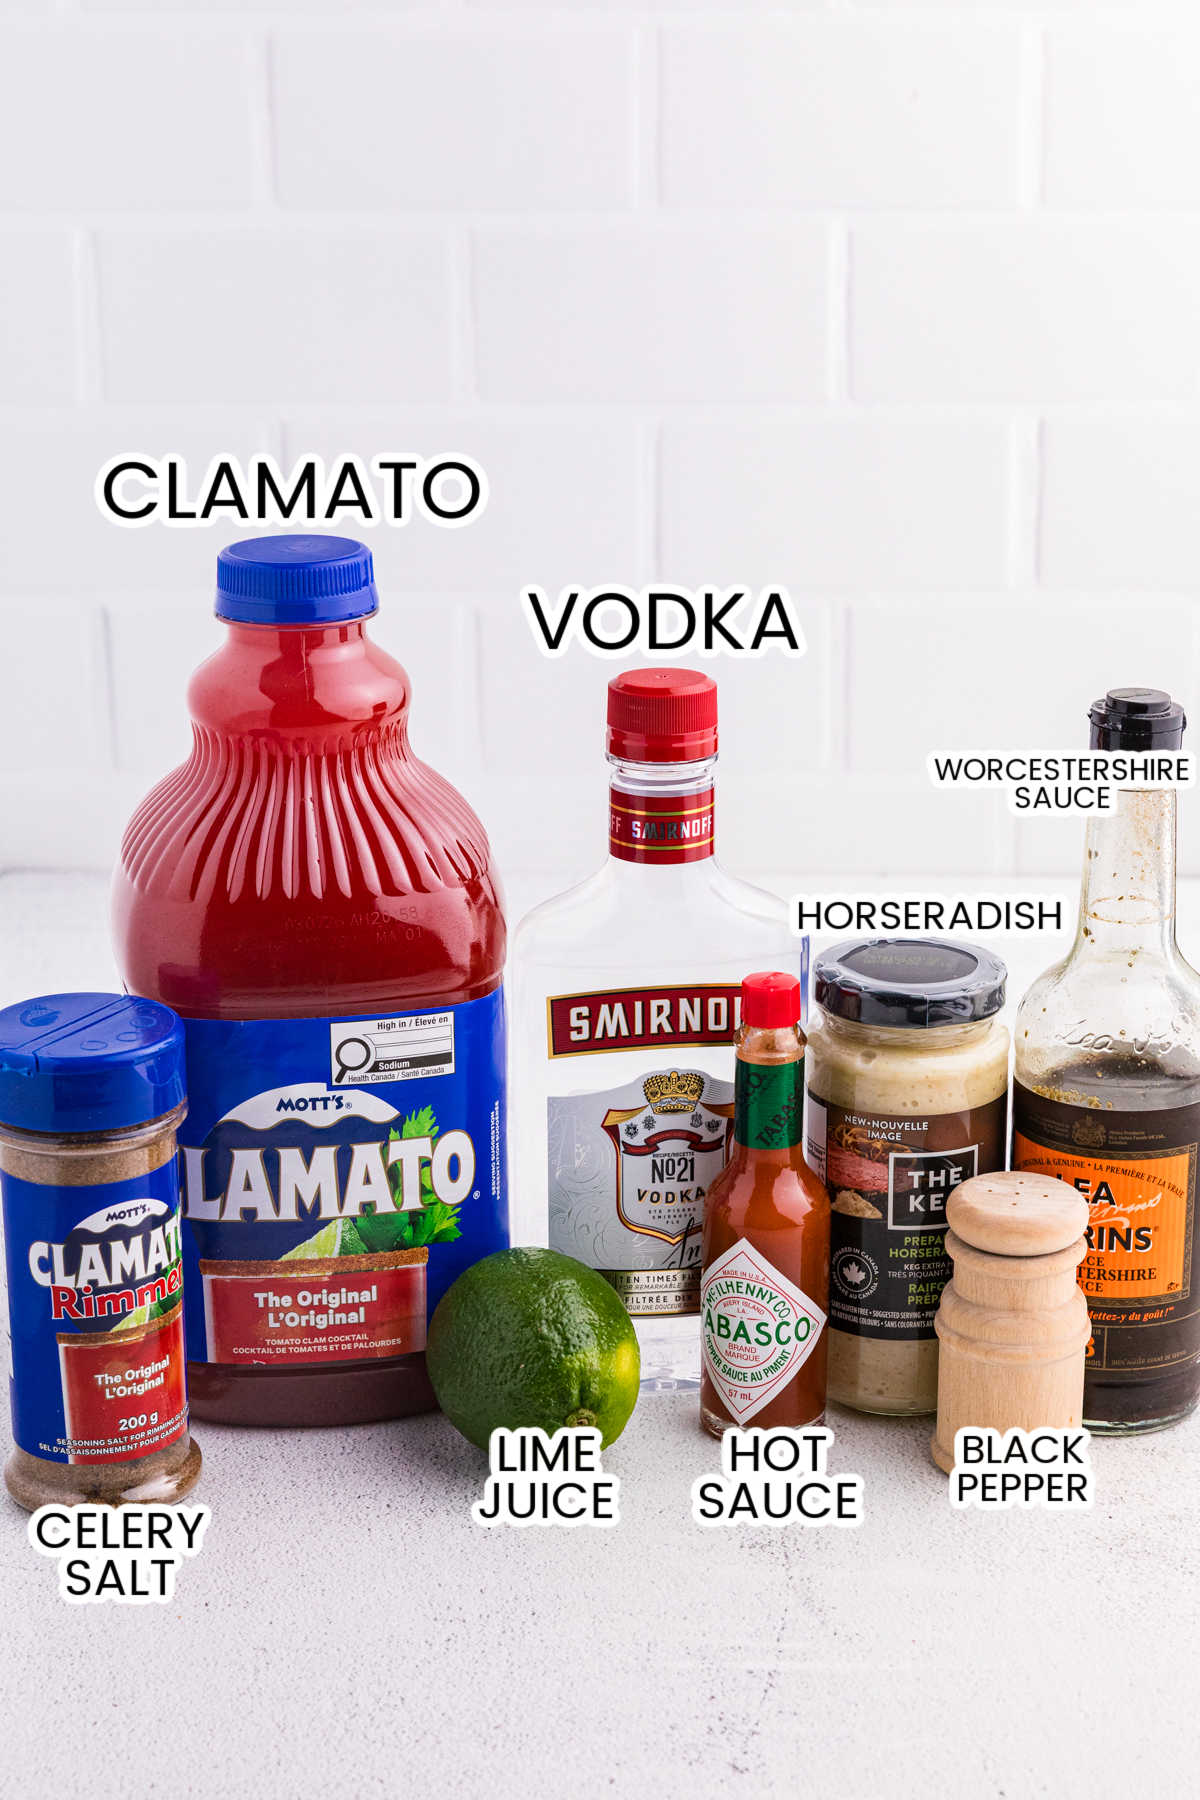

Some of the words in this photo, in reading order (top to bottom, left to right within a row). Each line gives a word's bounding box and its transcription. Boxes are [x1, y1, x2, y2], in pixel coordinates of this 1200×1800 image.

[632, 815, 712, 840] SMIRNOFF
[377, 1020, 396, 1031] High
[399, 1020, 407, 1028] in
[415, 1017, 436, 1027] Élevé
[438, 1016, 449, 1024] en
[379, 1061, 410, 1070] Sodium
[348, 1074, 370, 1083] Health
[371, 1072, 396, 1082] Canada
[401, 1069, 420, 1079] Santé
[421, 1066, 445, 1076] Canada
[275, 1095, 344, 1112] MOTT'S
[844, 1115, 866, 1126] NEW
[872, 1120, 929, 1131] NOUVELLE
[867, 1131, 902, 1141] IMAGE
[178, 1129, 476, 1222] LAMATO
[908, 1166, 963, 1189] THE
[1053, 1159, 1085, 1168] GENUINE
[1094, 1164, 1104, 1172] LA
[1146, 1174, 1157, 1184] ET
[1157, 1178, 1167, 1189] LA
[637, 1187, 706, 1205] VODKA
[909, 1193, 944, 1212] KE
[105, 1204, 147, 1222] MOTT'S
[904, 1236, 945, 1246] PREPA
[29, 1214, 182, 1287] CLAMAT
[646, 1274, 678, 1282] TIMES
[722, 1269, 739, 1277] MADE
[909, 1270, 944, 1278] PIQUANT
[51, 1260, 182, 1319] Rimmer
[253, 1291, 292, 1308] The
[297, 1285, 377, 1308] Original
[624, 1295, 669, 1304] FILTRÉE
[907, 1293, 940, 1305] PRÉP
[268, 1306, 366, 1329] L'Original
[1129, 1311, 1141, 1320] du
[703, 1305, 811, 1347] ABASCO
[265, 1337, 300, 1346] TOMATO
[302, 1336, 326, 1345] CLAM
[328, 1333, 369, 1343] COCKTAIL
[276, 1346, 286, 1354] DE
[288, 1345, 328, 1353] TOMATES
[341, 1343, 352, 1351] DE
[354, 1337, 401, 1350] PALOURDES
[728, 1342, 757, 1354] BRAND
[724, 1350, 760, 1362] MARQUE
[94, 1374, 122, 1386] The
[125, 1354, 170, 1381] Original
[722, 1364, 748, 1382] SAUCE
[750, 1370, 762, 1382] AU
[764, 1349, 791, 1377] PIMENT
[105, 1372, 164, 1399] L'Original
[728, 1388, 737, 1399] 57
[740, 1391, 753, 1401] mL
[118, 1413, 147, 1431] 200
[150, 1411, 159, 1426] g
[56, 1438, 105, 1447] SEASONING
[107, 1436, 128, 1444] SALT
[130, 1431, 145, 1440] FOR
[147, 1417, 174, 1436] RIMMING
[39, 1443, 52, 1452] SEL
[53, 1442, 138, 1456] D'ASSAISONNEMENT
[140, 1435, 160, 1448] POUR
